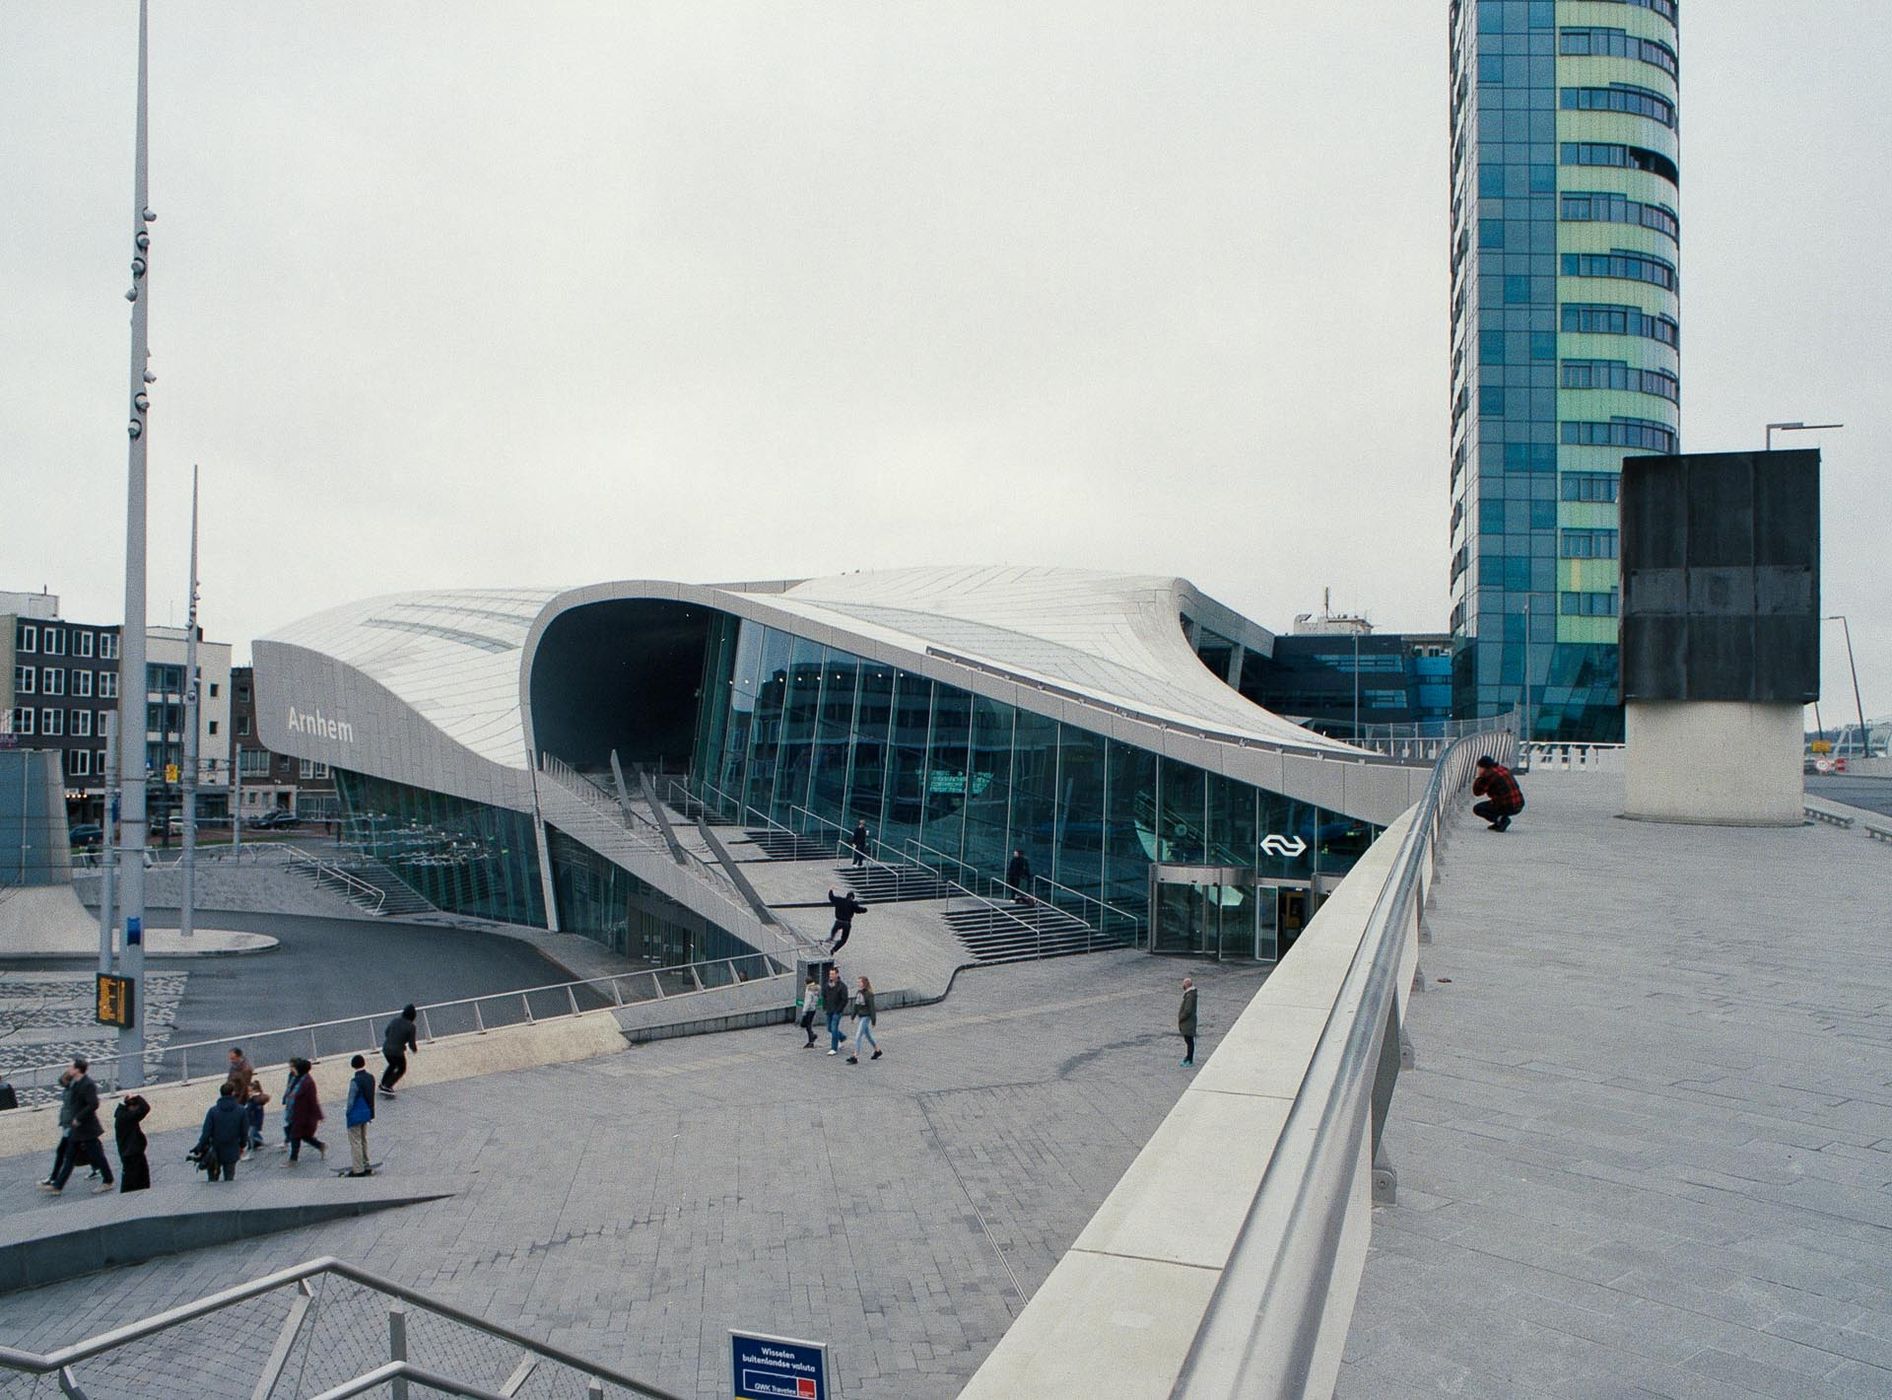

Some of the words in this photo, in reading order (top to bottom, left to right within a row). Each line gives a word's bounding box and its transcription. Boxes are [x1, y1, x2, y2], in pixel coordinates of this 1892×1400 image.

[288, 706, 353, 743] Arnhem
[742, 1353, 790, 1369] buitenlandse
[791, 1362, 816, 1373] valuta
[760, 1346, 796, 1360] Wisselen
